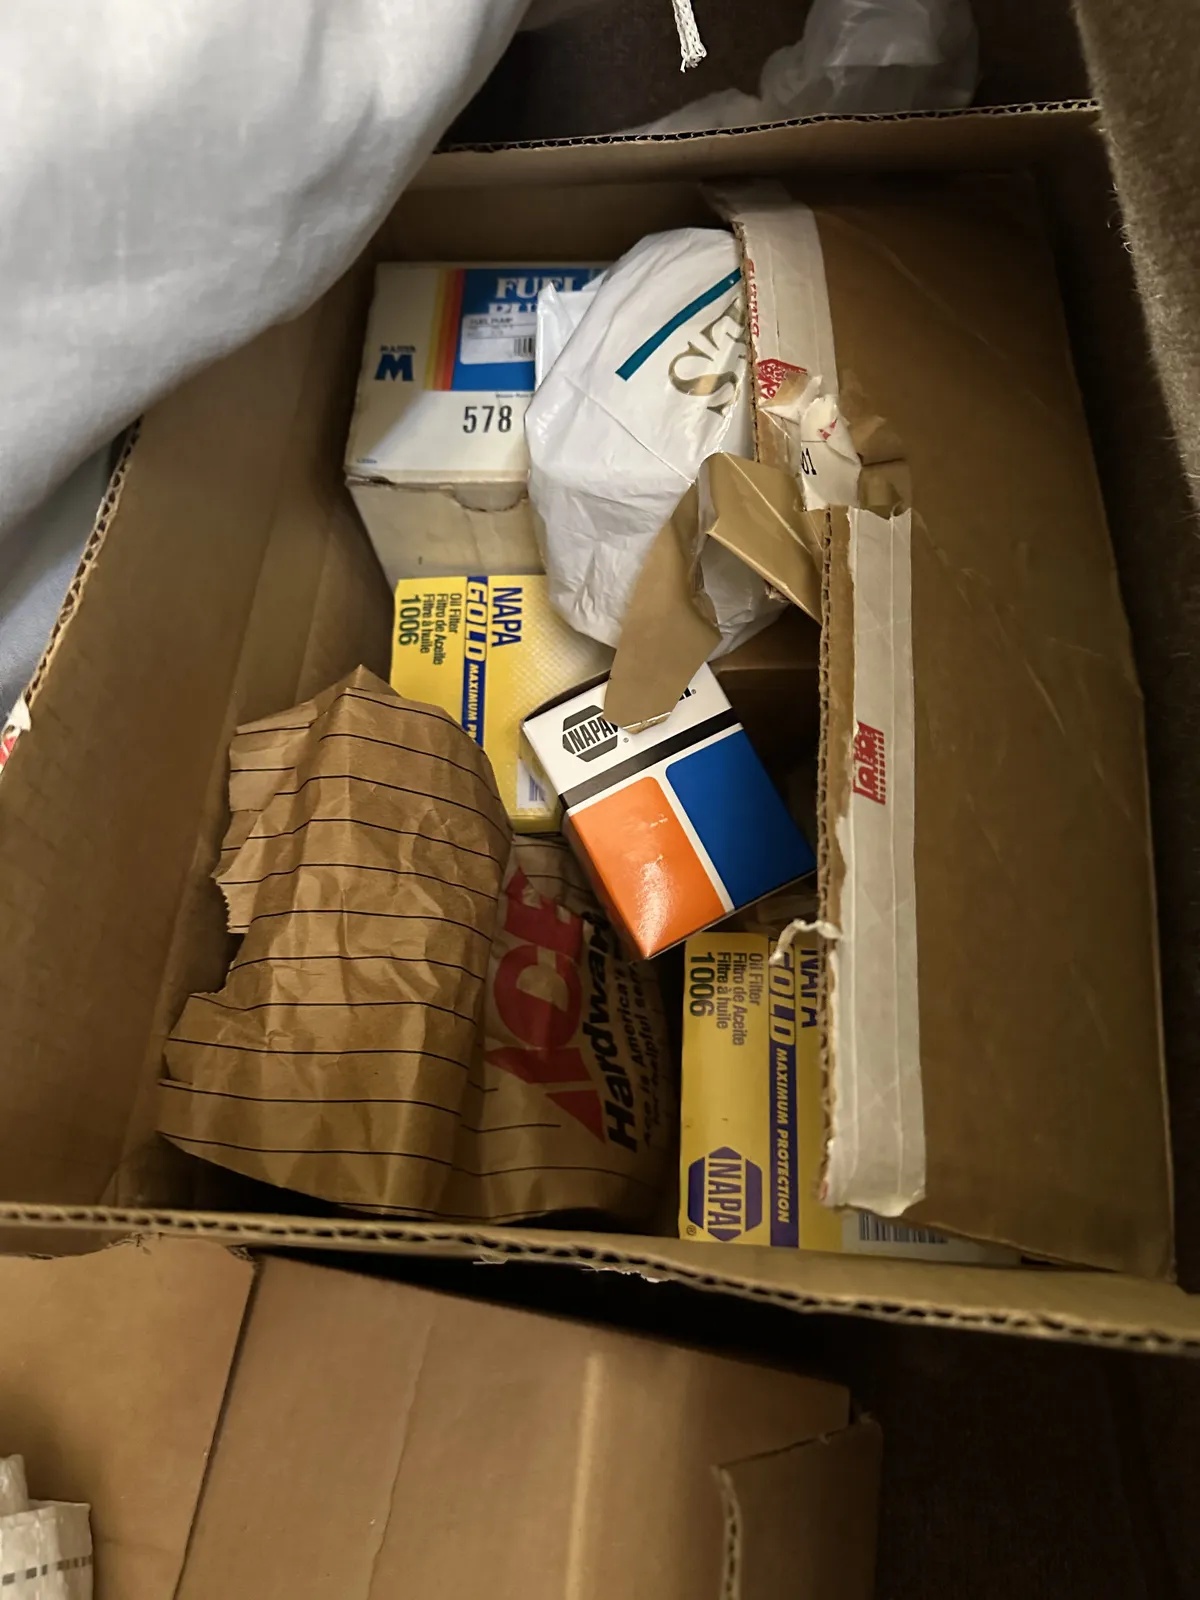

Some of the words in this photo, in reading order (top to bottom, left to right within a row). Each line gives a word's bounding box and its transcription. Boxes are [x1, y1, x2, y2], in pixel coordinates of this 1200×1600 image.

[462, 405, 513, 434] 578
[422, 593, 435, 618] Filtre
[435, 593, 448, 618] Filtro
[450, 592, 462, 607] Oil
[399, 594, 421, 646] 1006
[434, 619, 447, 632] de
[448, 608, 461, 634] Filter
[464, 581, 488, 662] GOLD
[491, 587, 523, 647] NAPA
[420, 629, 434, 654] huile
[433, 634, 447, 665] Aceite
[467, 663, 480, 722] MAXIMUM
[567, 715, 614, 753] NAPA
[716, 952, 731, 983] Filtre
[732, 952, 747, 984] Filtro
[748, 952, 763, 970] Oil
[689, 952, 715, 1018] 1006
[716, 986, 731, 995] à
[732, 986, 747, 1002] de
[749, 973, 764, 1006] Filter
[769, 941, 795, 1046] GOLD
[716, 996, 731, 1029] huile
[732, 1004, 748, 1046] Aceite
[774, 1047, 789, 1125] MAXIMUM
[776, 1127, 790, 1224] PROTECTION
[706, 1158, 742, 1235] NAPA
